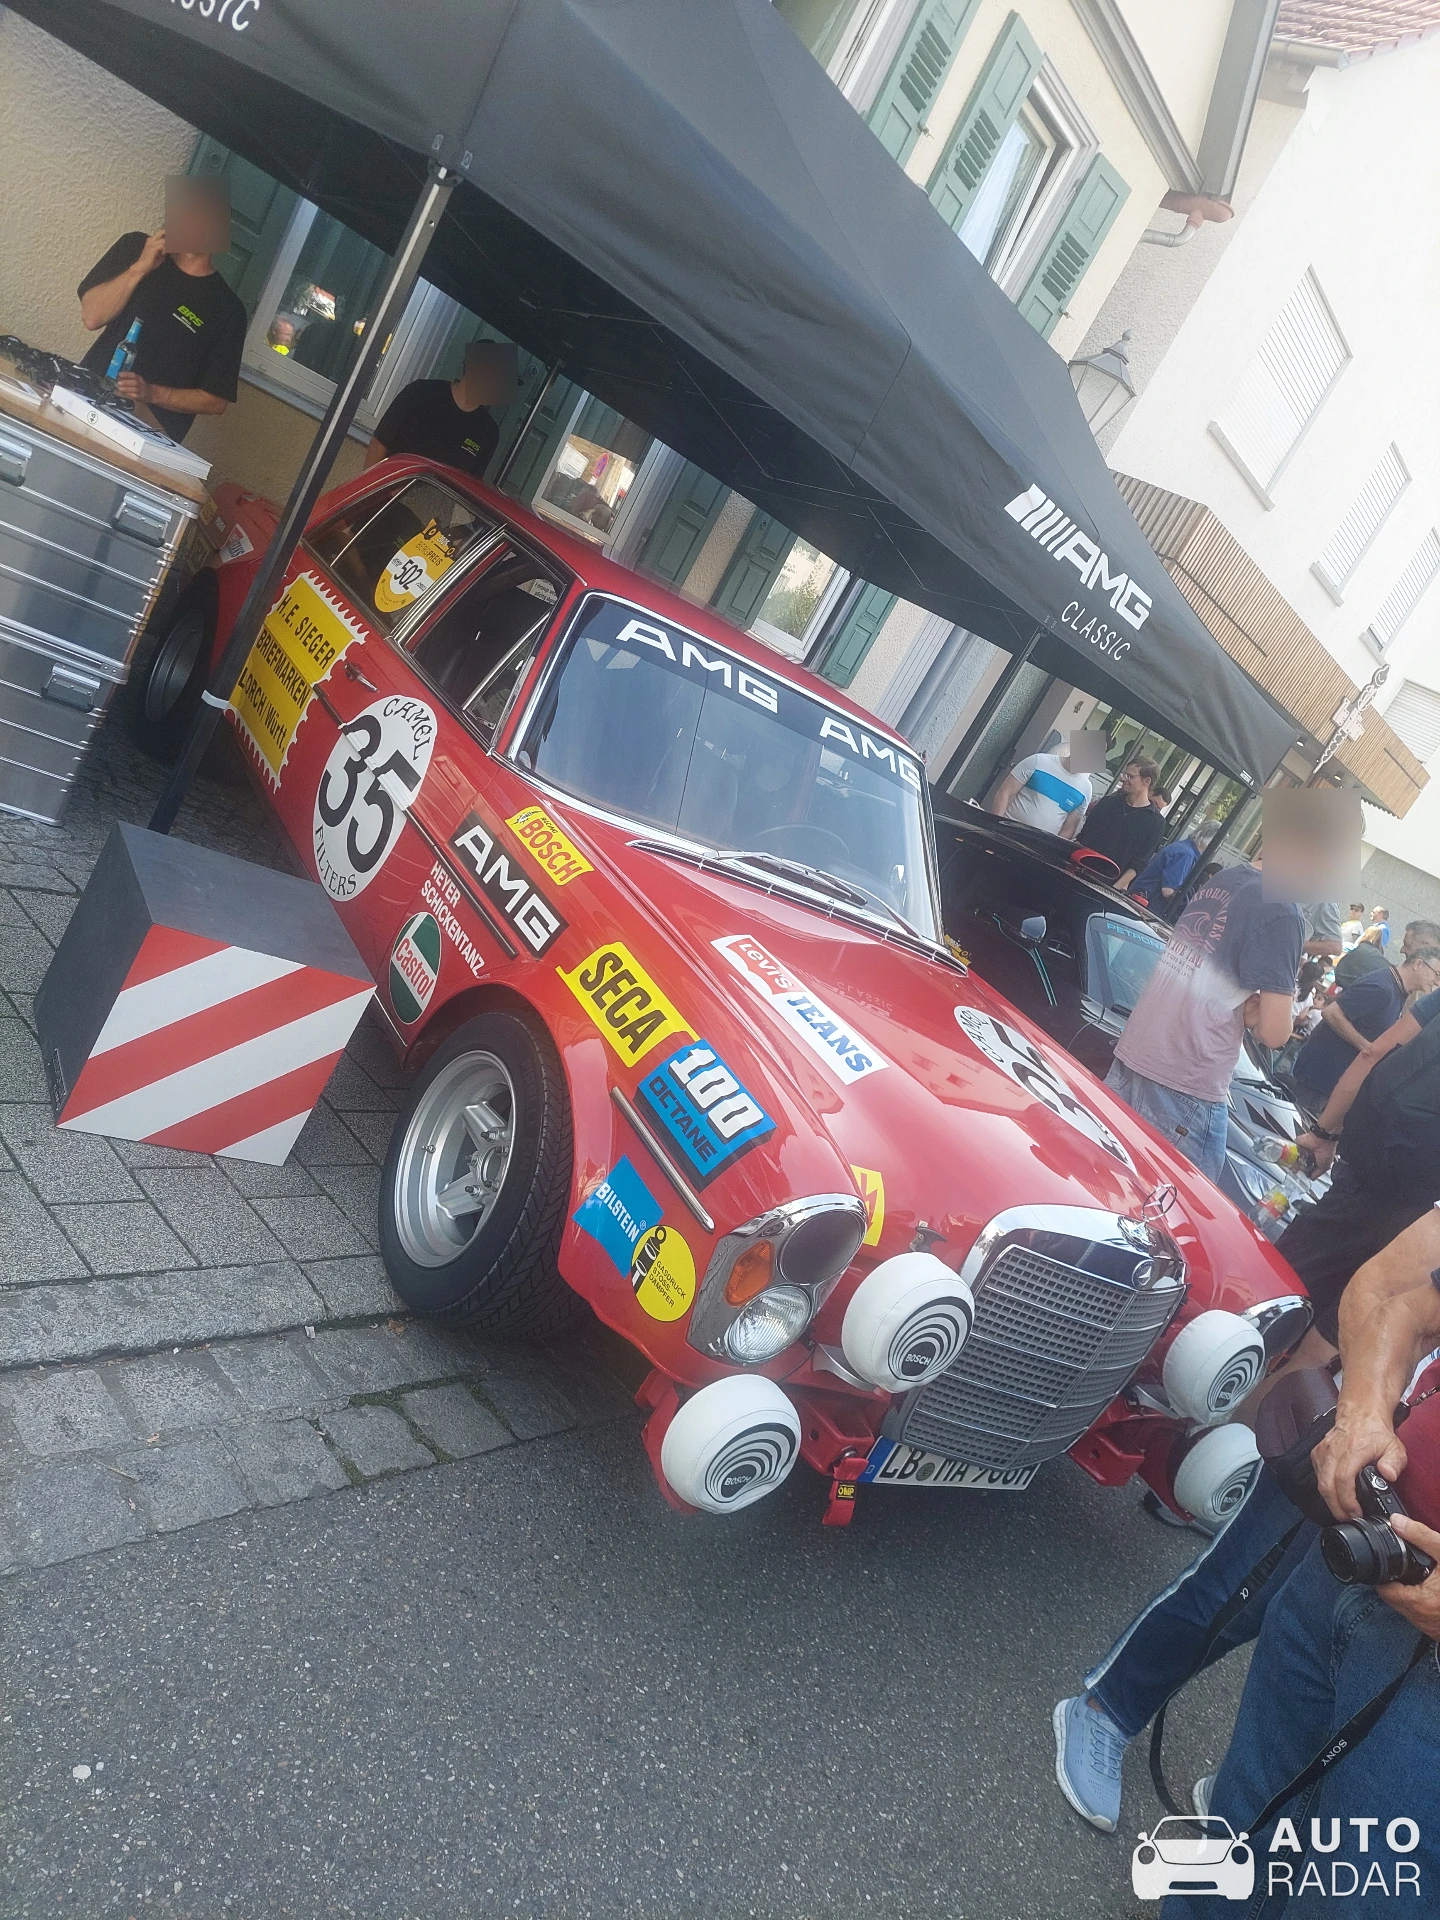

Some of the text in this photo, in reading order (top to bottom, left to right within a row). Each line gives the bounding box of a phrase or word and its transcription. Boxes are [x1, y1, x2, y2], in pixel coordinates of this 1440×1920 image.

[177, 305, 204, 327] BRS
[393, 559, 423, 591] 502
[415, 541, 444, 567] BERGPREIS
[1053, 530, 1152, 630] AMG
[276, 594, 336, 669] H.E. SIEGER
[1061, 601, 1131, 661] CLASSIC
[256, 630, 312, 709] BRIEFMARKEN
[616, 619, 778, 714] AMG
[383, 698, 433, 760] CAMEL
[819, 716, 922, 792] AMG
[318, 714, 422, 873] 35
[315, 824, 357, 896] FILTERS
[518, 818, 583, 882] BOSCH
[430, 860, 461, 908] HEYER
[454, 824, 560, 951] AMG
[421, 879, 485, 979] SCHICKENTANZ
[395, 937, 435, 1001] Castrol
[579, 951, 669, 1055] SECA
[787, 996, 873, 1072] JEANS
[648, 1076, 718, 1163] OCTANE
[668, 1048, 765, 1141] 100
[595, 1182, 640, 1243] BILSTEIN
[656, 1260, 687, 1300] GASDRUCK
[906, 1352, 931, 1366] BOSCH
[724, 1474, 751, 1486] BOSCH
[838, 1485, 854, 1497] OMP
[866, 1464, 875, 1474] D
[879, 1444, 926, 1481] LB
[1321, 1739, 1348, 1767] SONY
